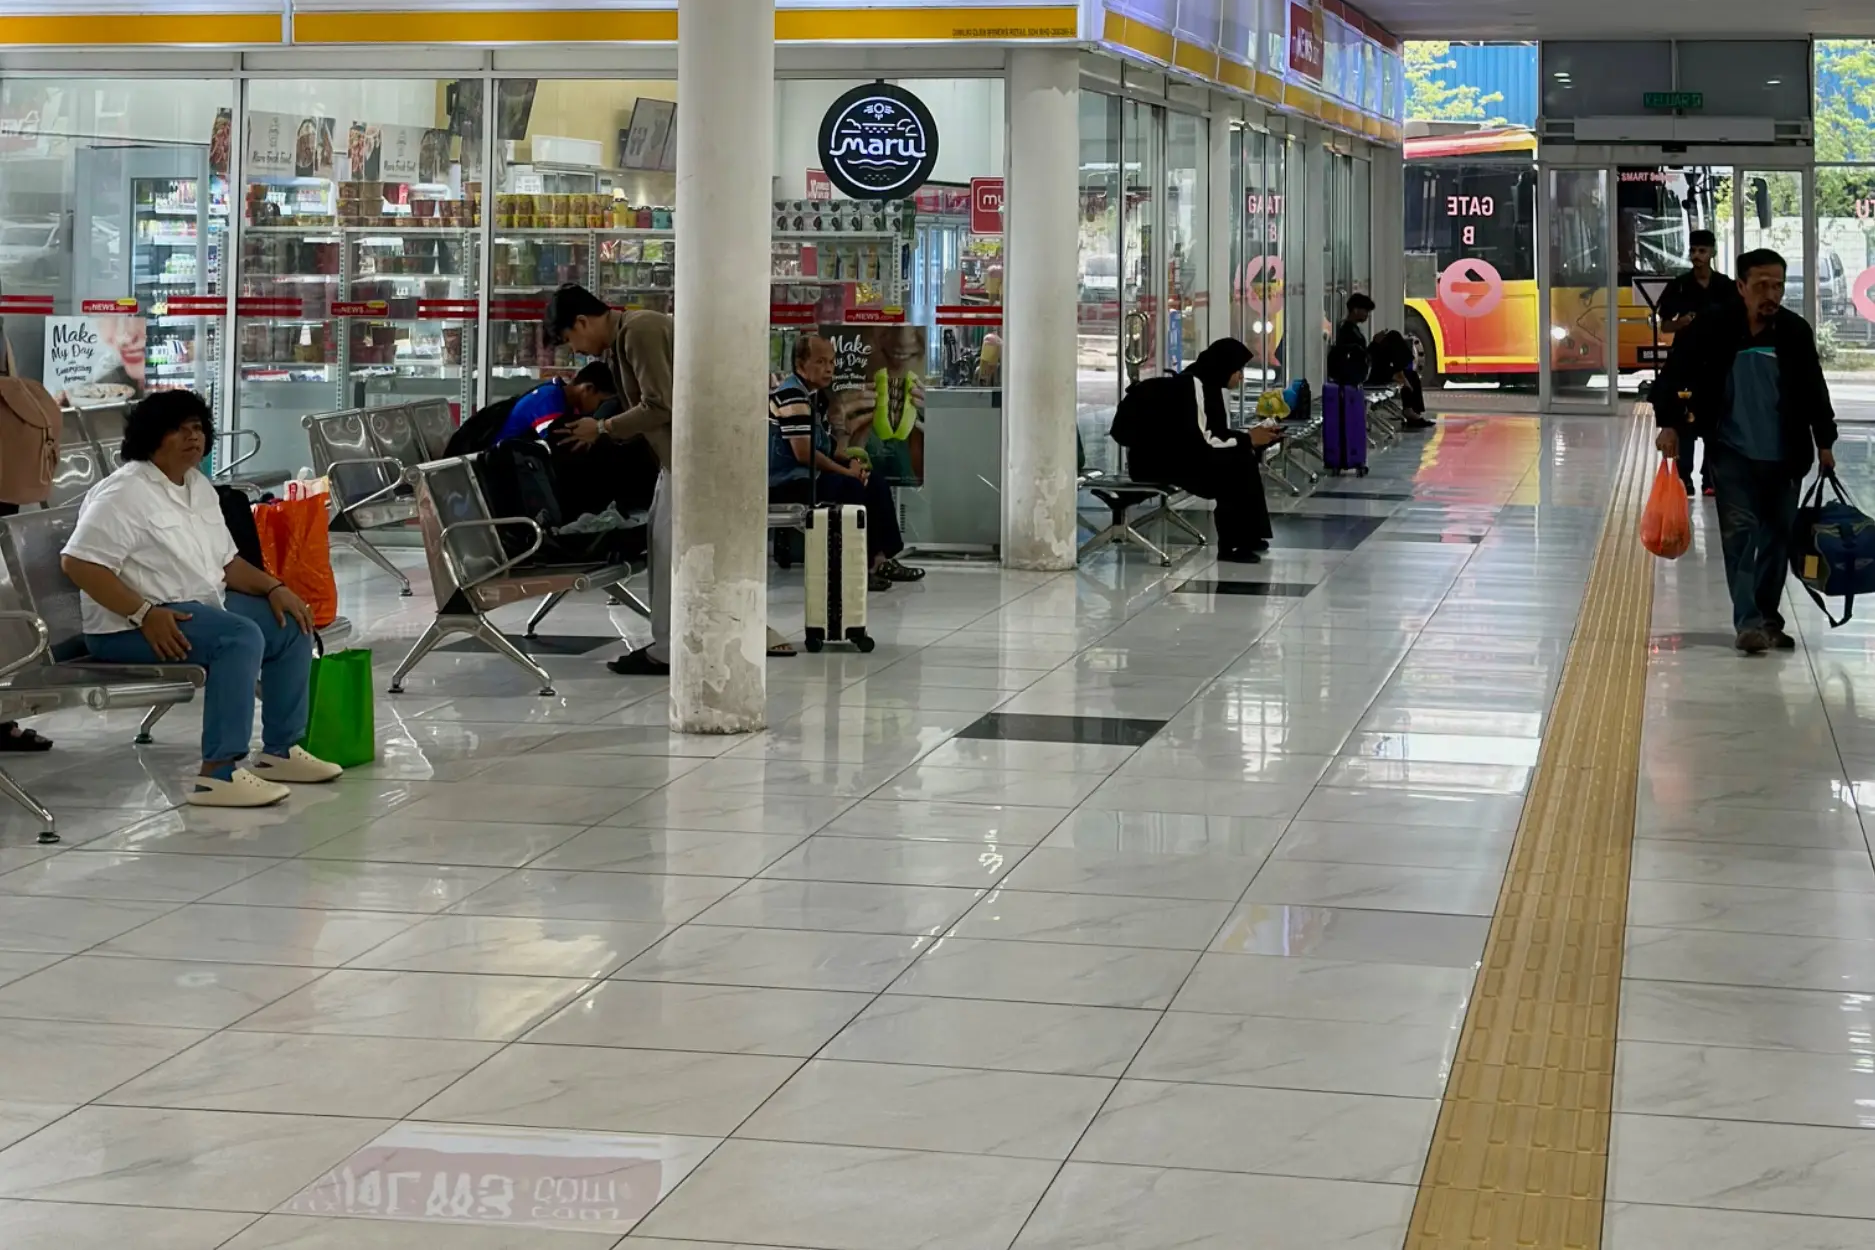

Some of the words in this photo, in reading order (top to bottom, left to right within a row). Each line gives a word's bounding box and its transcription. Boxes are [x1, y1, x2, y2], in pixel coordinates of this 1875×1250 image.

[829, 137, 926, 158] maru
[1622, 172, 1648, 182] SMART
[53, 322, 97, 348] Make
[830, 334, 872, 355] Make
[51, 346, 68, 362] My
[72, 344, 94, 359] Day
[847, 353, 868, 368] Day
